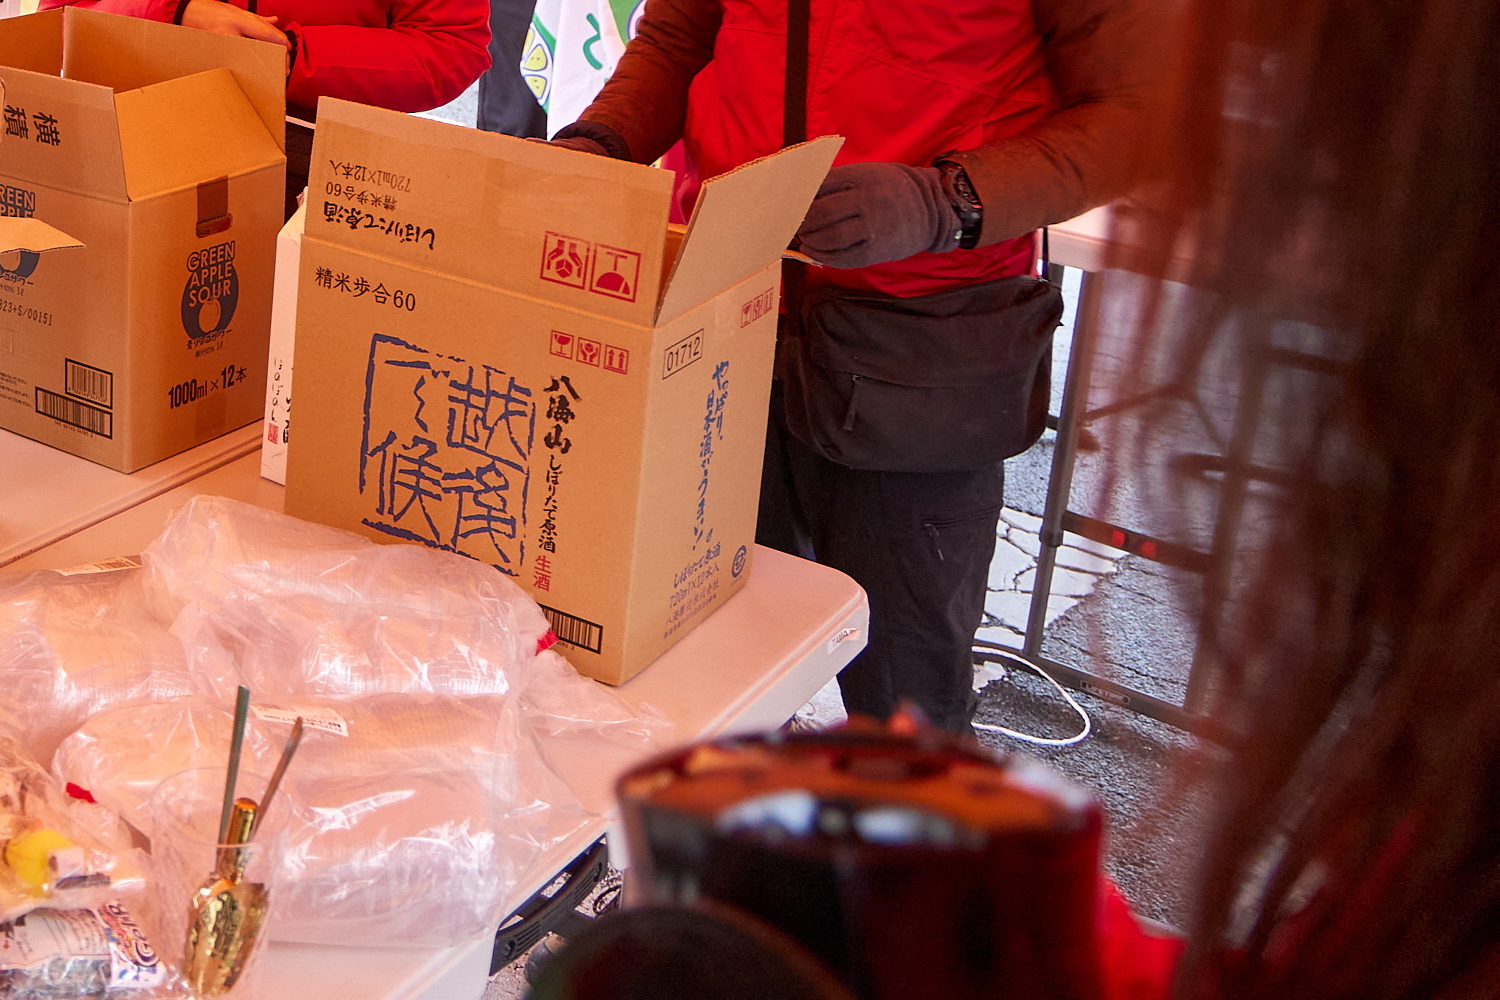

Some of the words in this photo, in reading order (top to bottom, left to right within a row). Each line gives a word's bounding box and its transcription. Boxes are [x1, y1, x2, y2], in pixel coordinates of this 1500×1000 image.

[326, 182, 397, 211] 精米歩合60
[324, 201, 435, 250] しぼりたて原酒
[187, 241, 235, 272] GREEN
[190, 261, 232, 288] APPLE
[315, 266, 416, 312] 精米歩合60
[189, 279, 231, 307] SOUR
[667, 337, 700, 371] 01712
[168, 378, 207, 409] 1000ml
[543, 375, 582, 454] 八海山
[538, 454, 562, 554] しぼりたて原酒
[533, 555, 551, 592] 生酒
